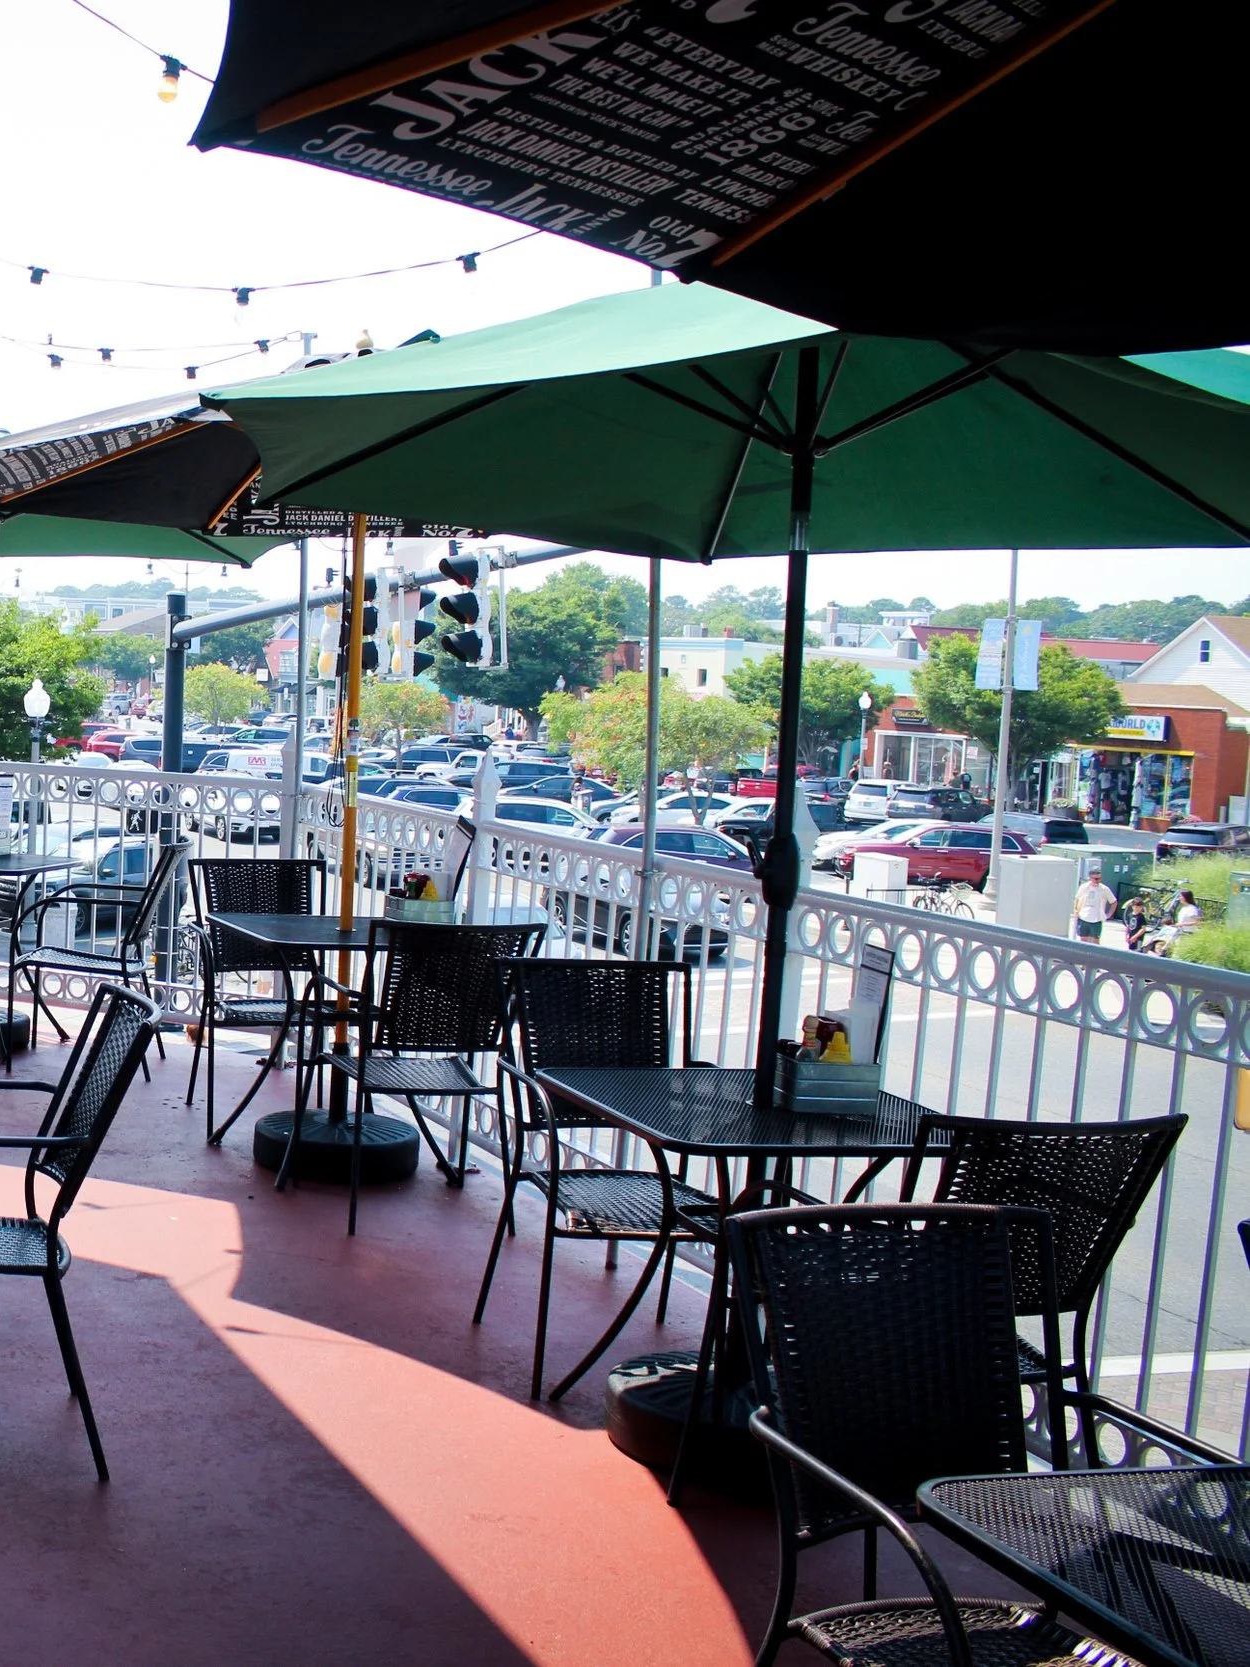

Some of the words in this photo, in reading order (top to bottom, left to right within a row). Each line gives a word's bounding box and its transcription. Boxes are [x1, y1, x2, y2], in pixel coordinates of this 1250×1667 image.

[612, 41, 659, 67] WE
[651, 59, 727, 95] MAKE
[791, 2, 942, 88] Tennessee
[369, 31, 609, 141] JACK
[548, 72, 592, 96] THE
[578, 85, 633, 110] BEST
[617, 100, 654, 119] WE
[581, 56, 646, 91] WE'LL
[639, 82, 705, 112] MAKE
[692, 103, 724, 118] IT
[728, 67, 782, 91] DAY
[786, 46, 903, 103] WHISKEY
[301, 123, 493, 196] Tennessee
[457, 118, 520, 145] JACK
[507, 134, 588, 168] DANIEL
[572, 154, 681, 195] DISTILLERY
[494, 106, 593, 144] DISTILLED
[588, 139, 605, 149] &
[603, 143, 680, 173] BOTTLED
[674, 167, 700, 180] BY
[699, 112, 816, 166] 1866
[435, 136, 551, 177] LYNCHBURG
[548, 171, 646, 207] TENNESSEE
[648, 215, 696, 237] Old
[649, 227, 725, 269] 7
[242, 523, 330, 536] Tennessee
[311, 514, 346, 522] DANIEL
